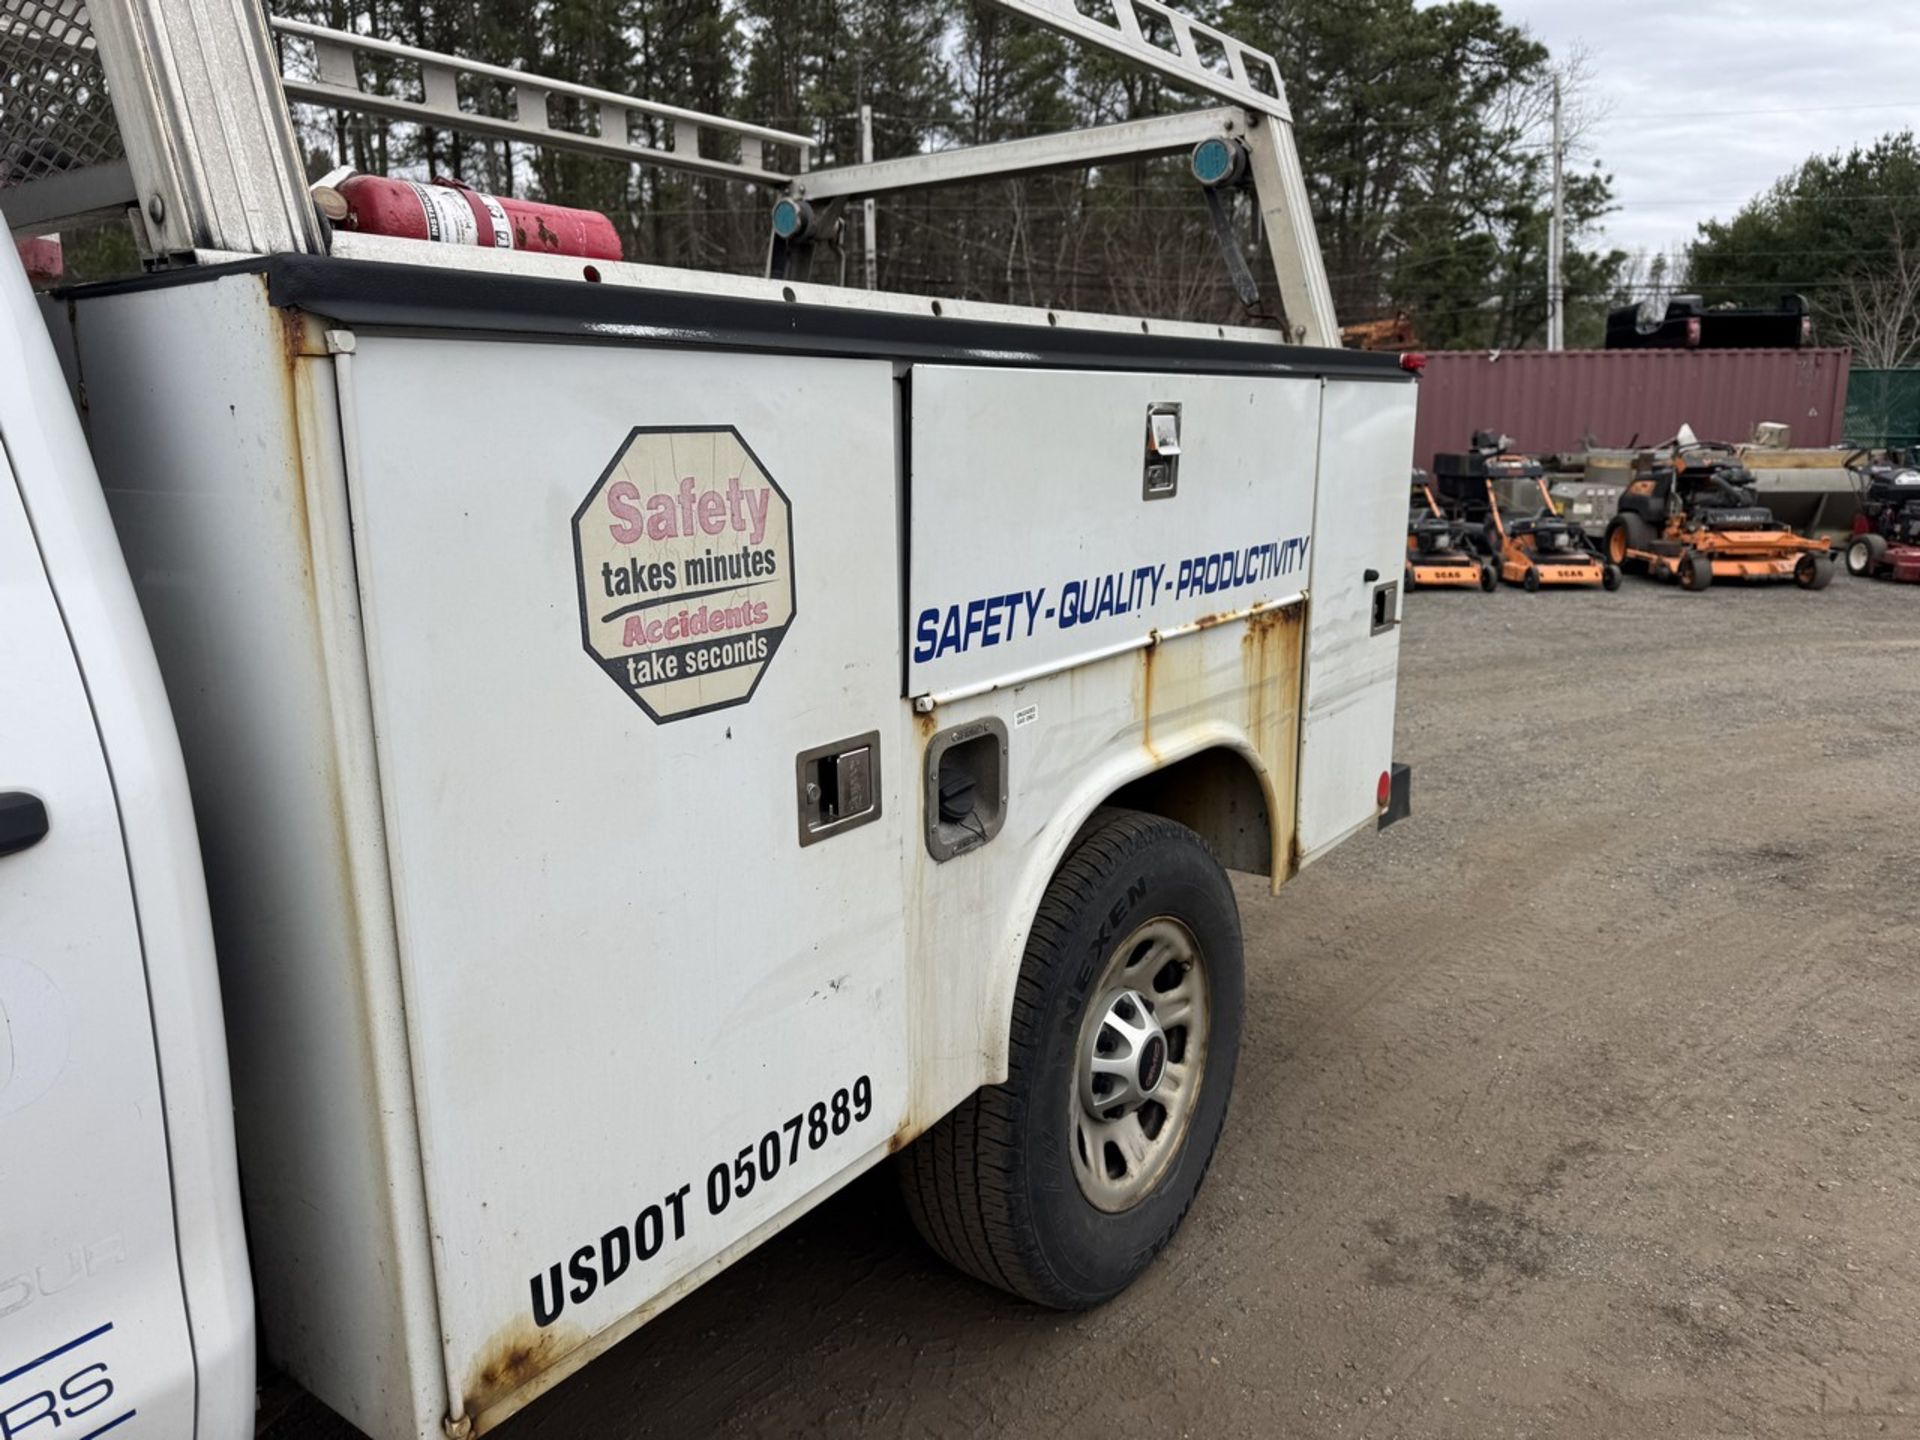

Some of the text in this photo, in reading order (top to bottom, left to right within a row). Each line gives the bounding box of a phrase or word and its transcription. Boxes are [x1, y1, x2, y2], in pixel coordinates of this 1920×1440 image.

[606, 476, 771, 546] Safety
[601, 545, 776, 598] takes minutes
[622, 601, 769, 648] Accidents
[626, 633, 768, 686] take seconds
[1060, 876, 1148, 1034] NEXEN
[529, 1074, 873, 1328] USDOT 0507889
